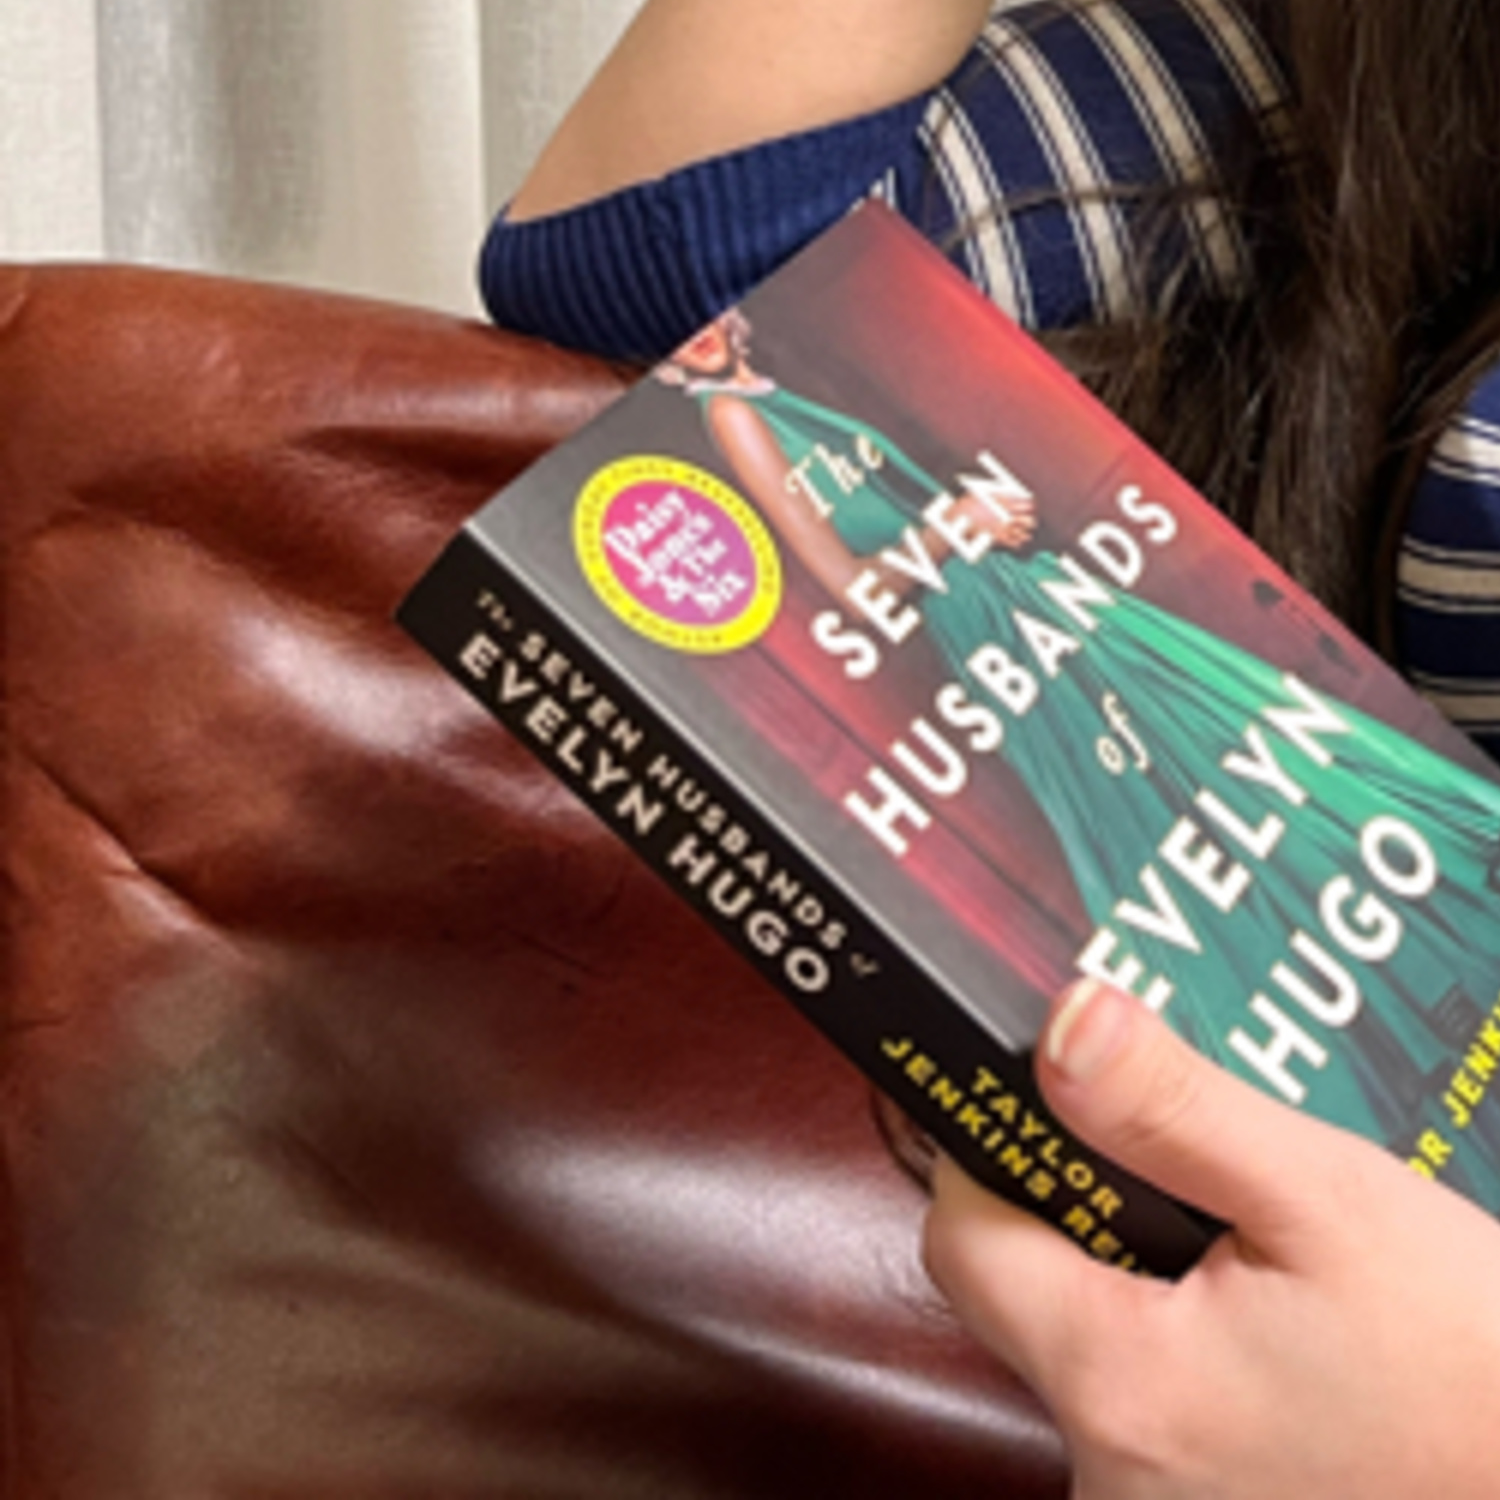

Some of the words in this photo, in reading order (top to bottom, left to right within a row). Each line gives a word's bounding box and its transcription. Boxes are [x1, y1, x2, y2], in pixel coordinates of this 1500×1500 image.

[786, 434, 883, 518] The
[810, 450, 1034, 678] SEVEN
[520, 631, 643, 752] SEVEN
[647, 754, 848, 950] HUSBANDS
[844, 486, 1178, 857] HUSBANDS
[1096, 691, 1149, 775] of
[460, 632, 664, 834] EVELYN
[668, 832, 830, 992] HUGO
[1075, 673, 1353, 1012] EVELYN
[1227, 815, 1437, 1105] HUGO
[881, 1039, 1057, 1199] JENKINS
[1063, 1206, 1150, 1276] REI
[972, 1066, 1123, 1219] TAYLOR
